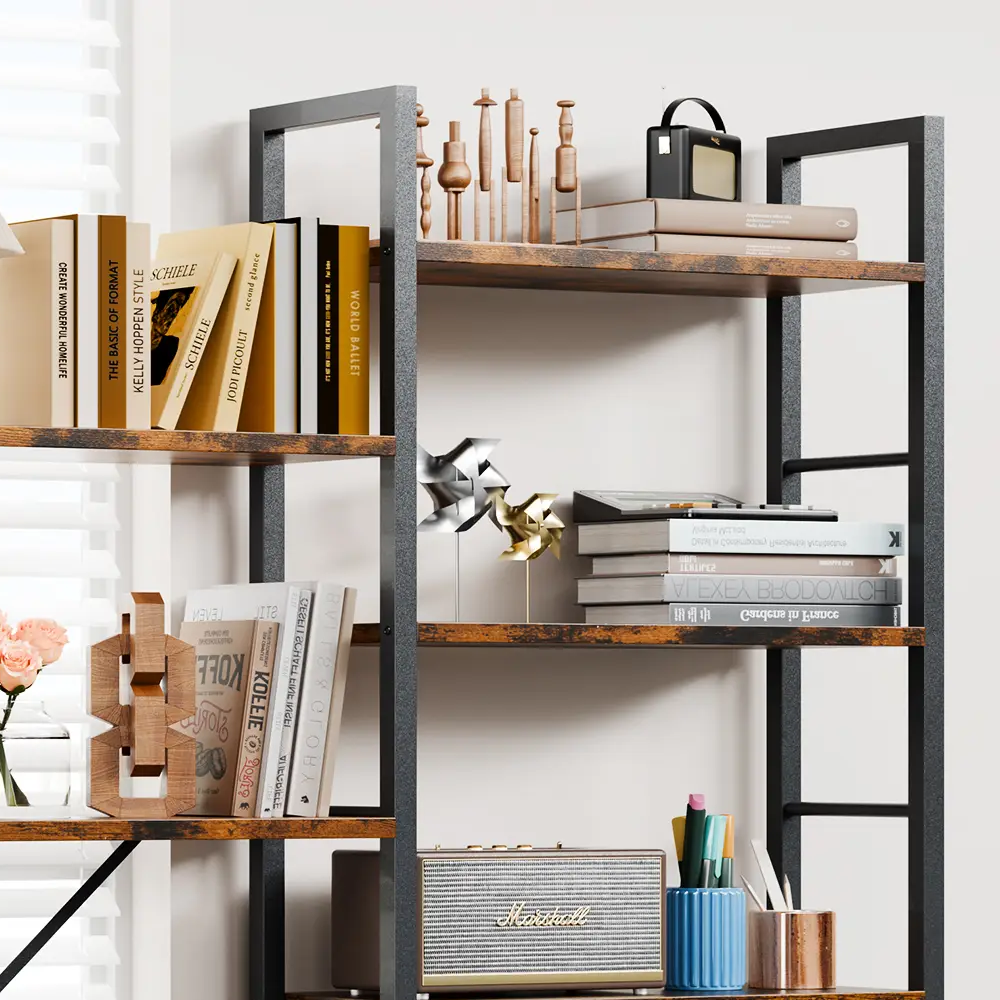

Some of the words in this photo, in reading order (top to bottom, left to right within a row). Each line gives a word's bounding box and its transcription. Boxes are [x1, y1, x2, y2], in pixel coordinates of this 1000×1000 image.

[58, 262, 68, 290] CREATE
[108, 259, 119, 305] FORMAT
[150, 263, 198, 281] SCHIELE
[249, 253, 261, 280] glance
[133, 268, 144, 304] STYLE
[245, 282, 255, 311] second
[58, 293, 68, 340] WONDERFUL
[108, 309, 119, 323] OF
[350, 290, 361, 332] WORLD
[108, 326, 119, 357] BASIC
[133, 307, 144, 354] HOPPEN
[184, 317, 212, 371] SCHIELE
[58, 341, 68, 379] HOMELIFE
[108, 360, 119, 381] THE
[231, 329, 248, 376] PICOULT
[350, 336, 361, 377] BALLET
[133, 357, 144, 393] KELLY
[226, 377, 240, 403] JODI
[496, 901, 591, 927] Marshall
